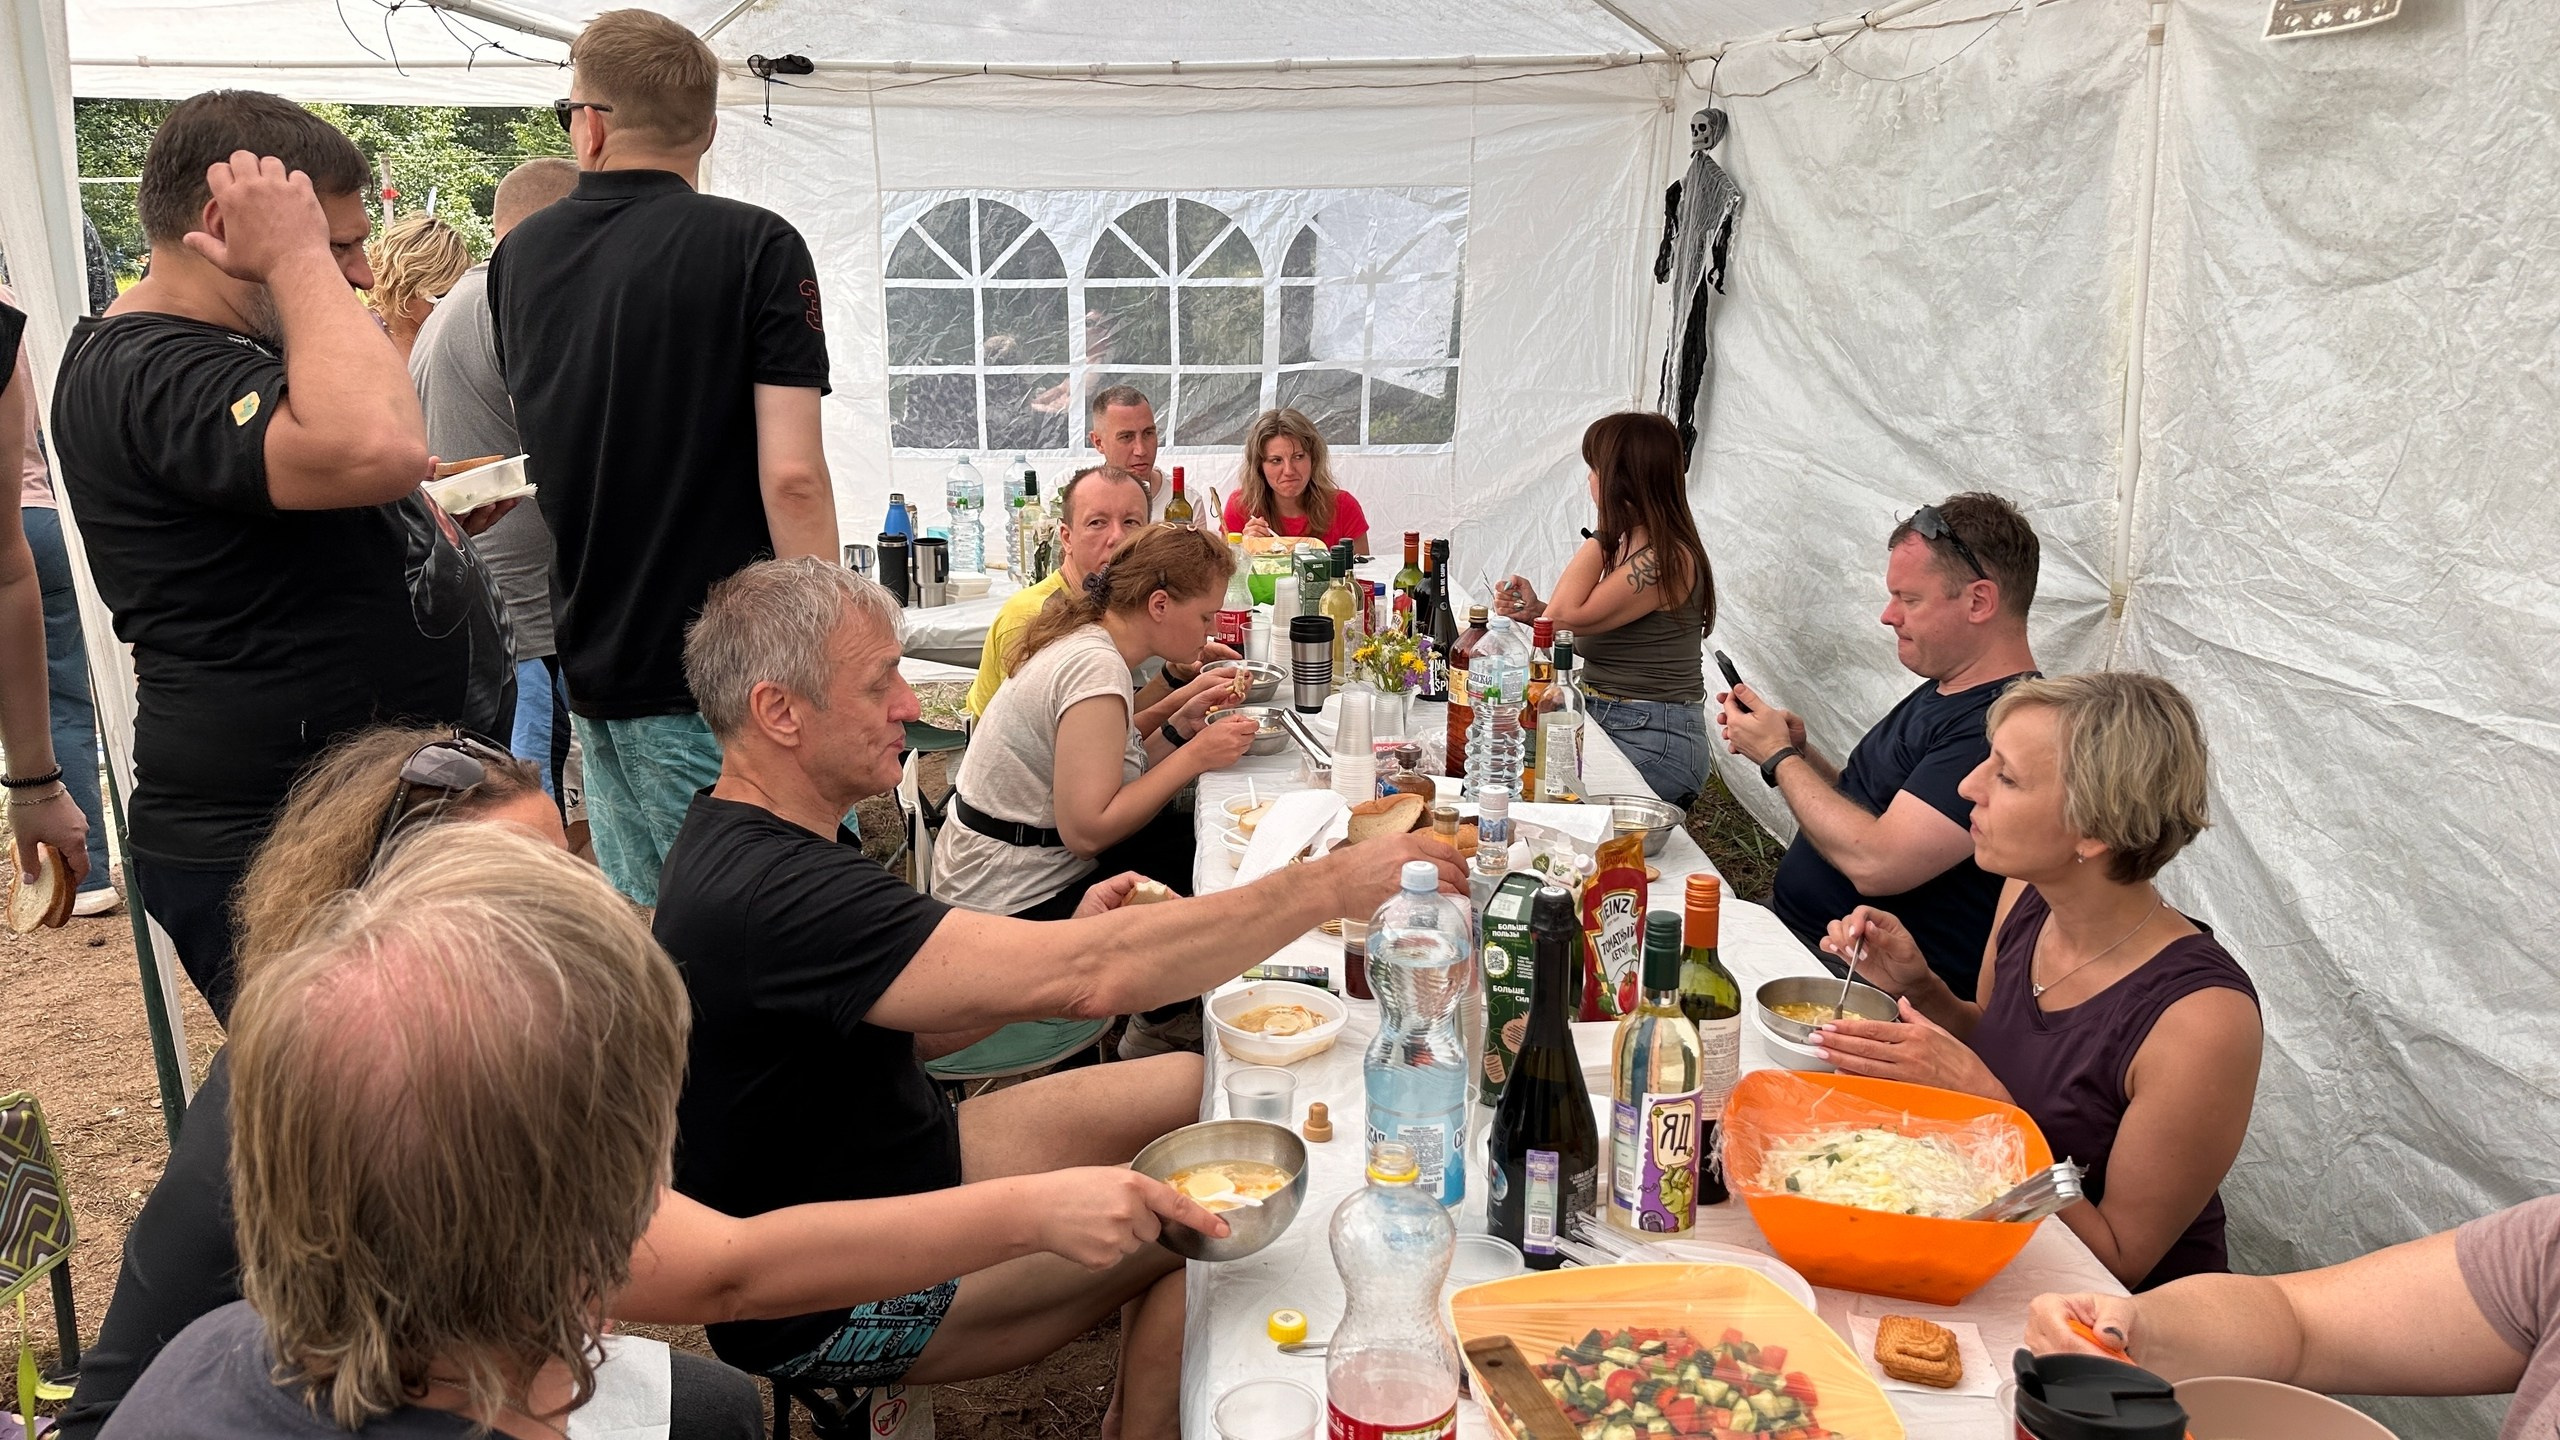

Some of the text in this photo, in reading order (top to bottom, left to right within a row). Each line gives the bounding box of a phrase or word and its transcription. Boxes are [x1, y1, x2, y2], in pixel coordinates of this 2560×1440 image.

[1434, 681, 1449, 692] SPI
[1497, 923, 1528, 931] БОЛЬШЕ
[1611, 942, 1631, 962] КЕТЧУП
[1492, 985, 1525, 995] БОЛЬШЕ
[1515, 995, 1530, 1003] СИЛ
[1660, 1113, 1691, 1156] ЯД
